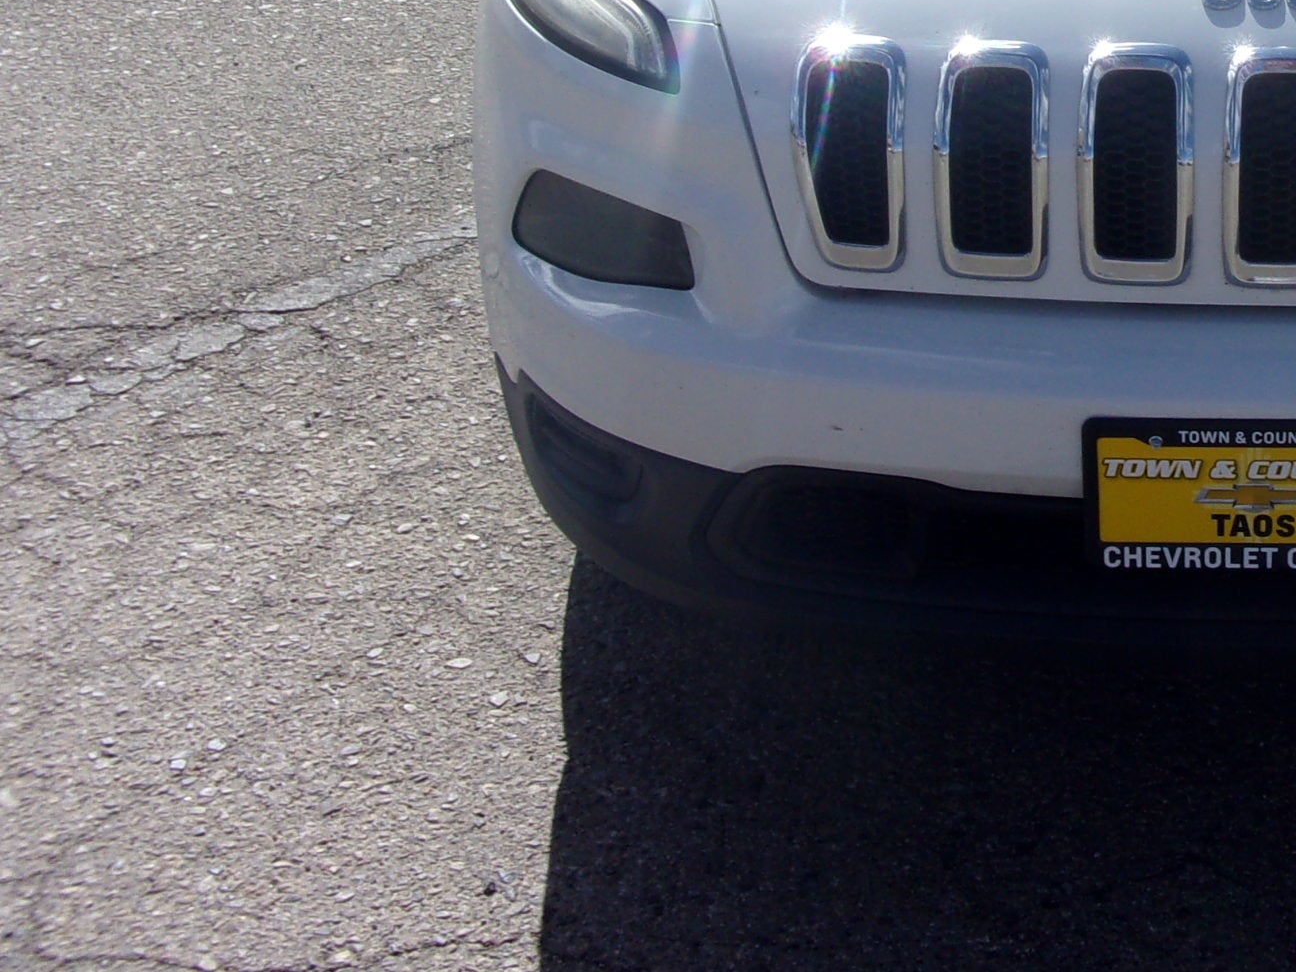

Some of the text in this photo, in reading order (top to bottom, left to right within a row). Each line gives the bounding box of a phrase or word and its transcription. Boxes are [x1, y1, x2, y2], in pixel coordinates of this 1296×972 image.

[1178, 430, 1231, 444] TOWN
[1235, 431, 1247, 444] &
[1103, 458, 1203, 479] TOWN
[1210, 459, 1238, 479] &
[1211, 514, 1296, 537] TAOS
[1103, 546, 1277, 568] CHEVROLET
